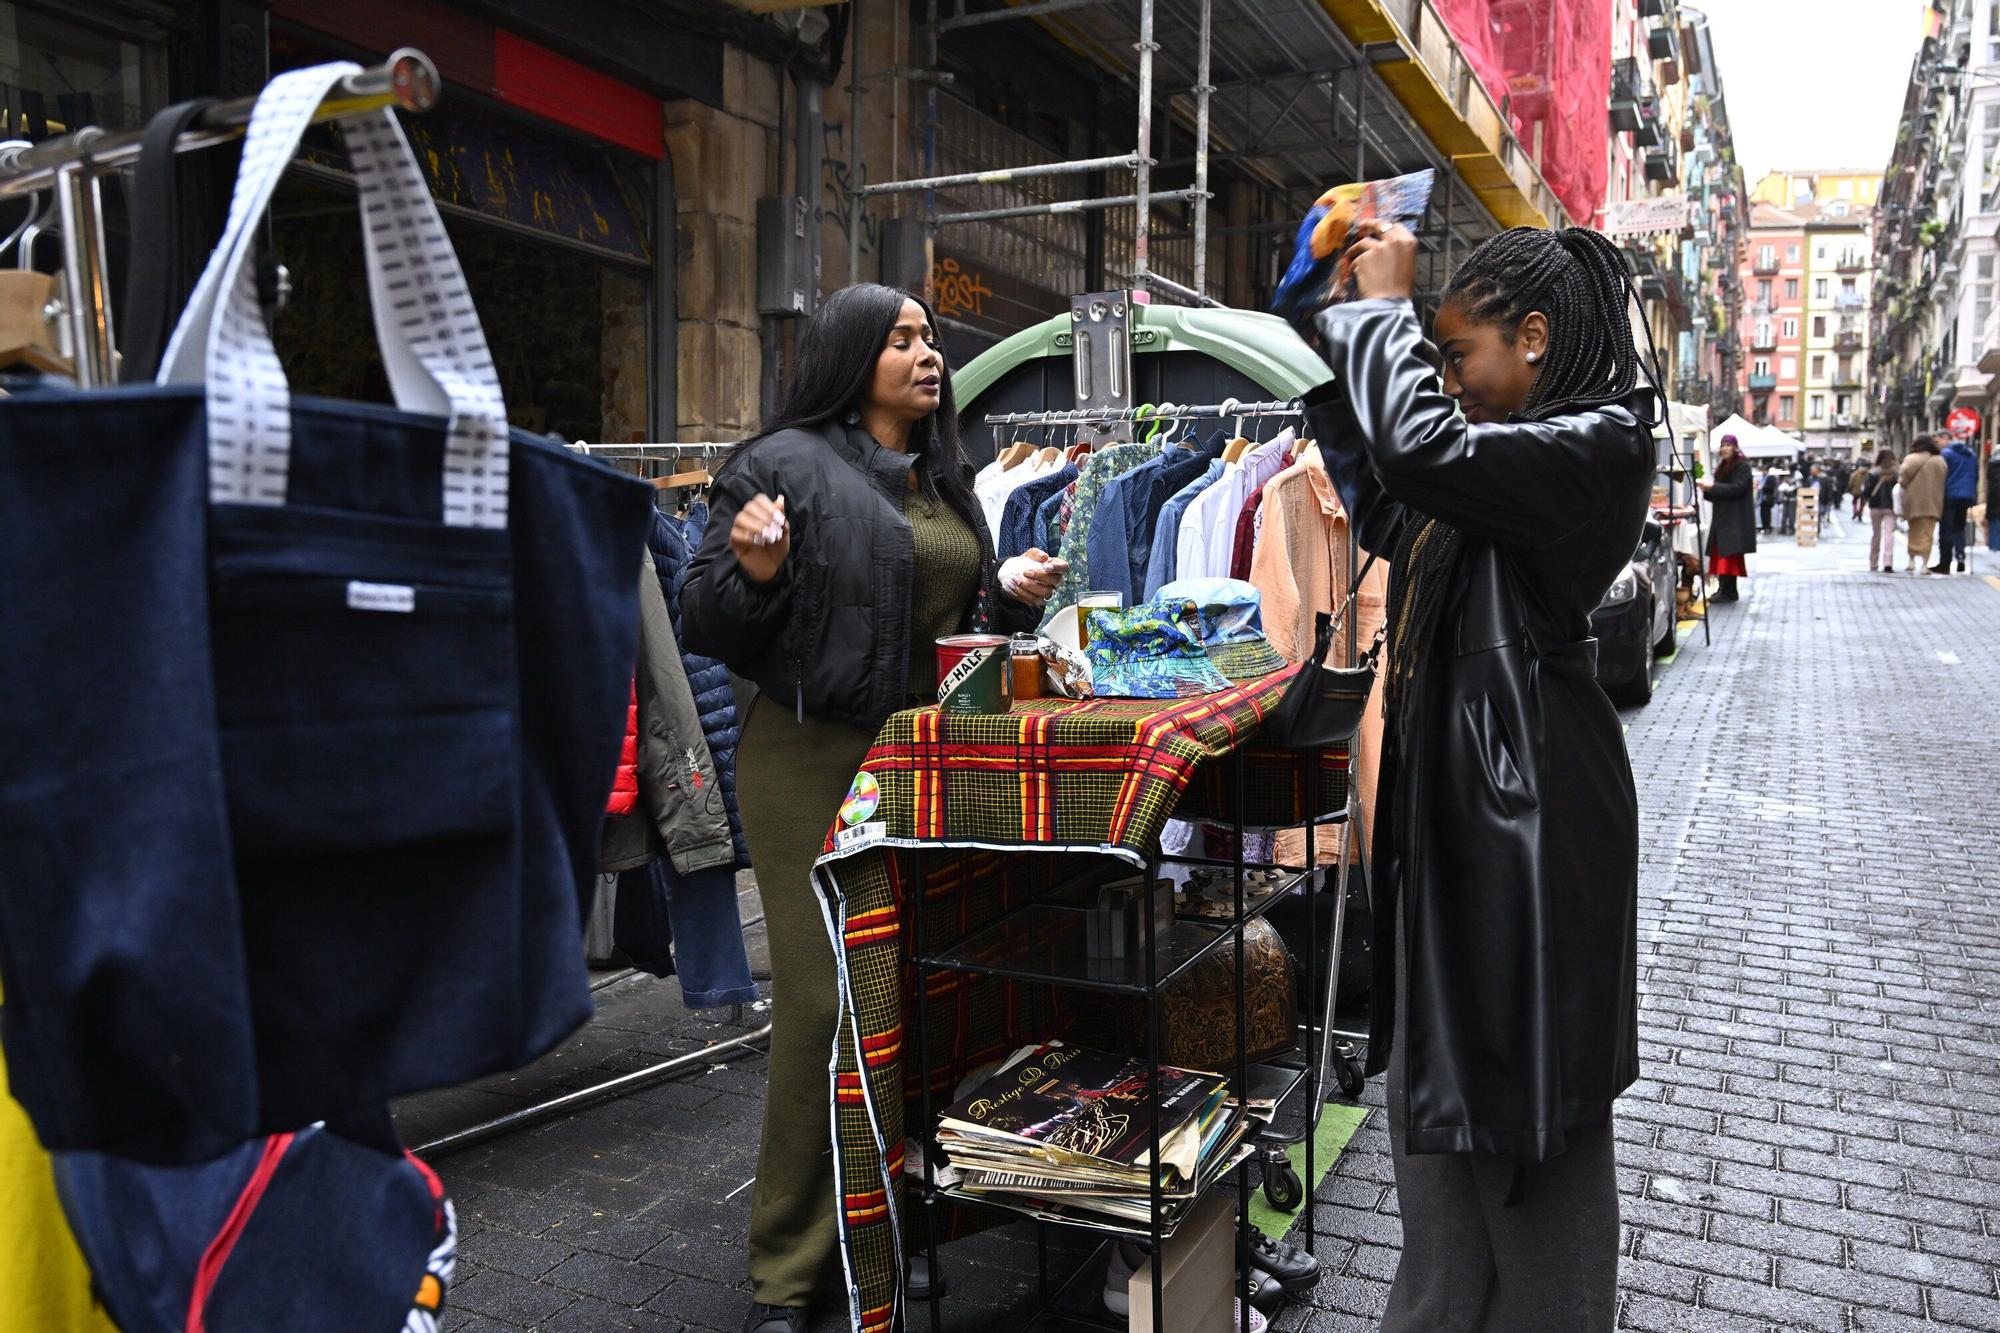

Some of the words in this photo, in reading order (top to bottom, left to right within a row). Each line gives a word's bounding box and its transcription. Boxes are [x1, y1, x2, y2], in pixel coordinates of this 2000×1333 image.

[938, 680, 951, 705] ALF
[952, 650, 982, 682] HALF
[968, 1083, 1025, 1119] Prestige
[1018, 1067, 1048, 1086] De
[1043, 1048, 1081, 1069] Paris
